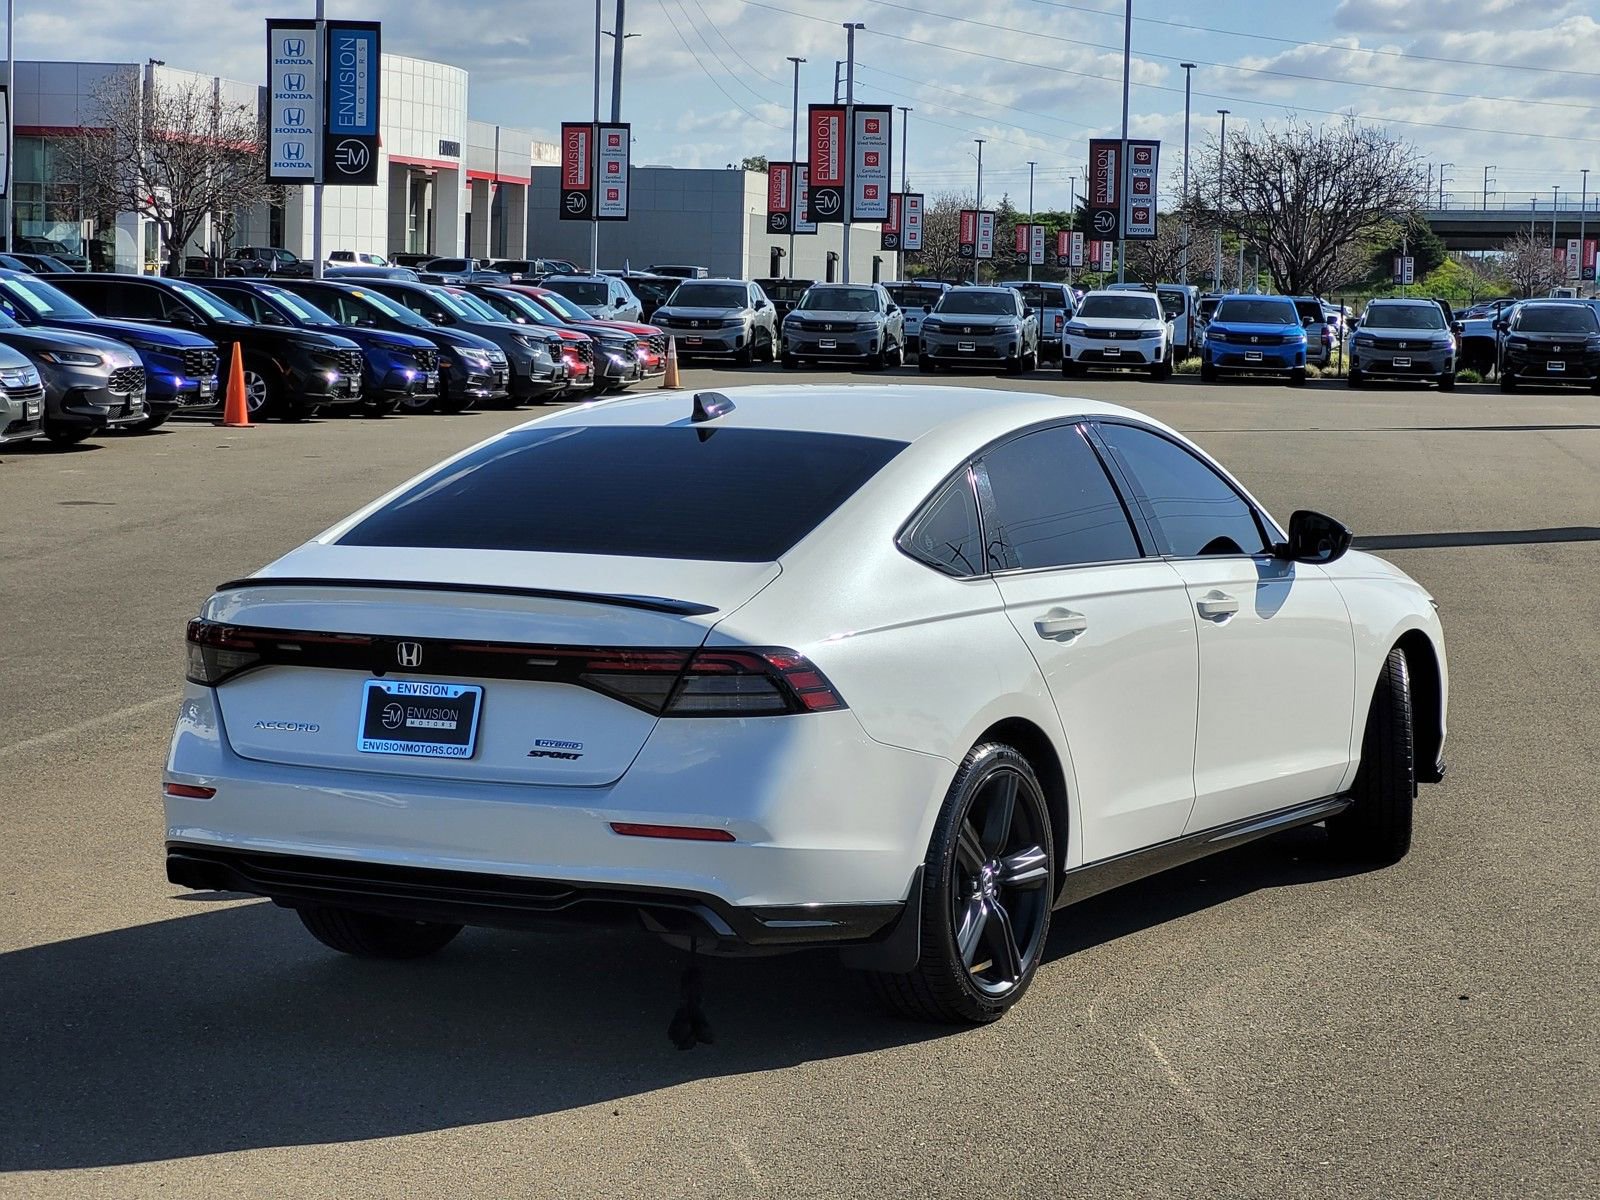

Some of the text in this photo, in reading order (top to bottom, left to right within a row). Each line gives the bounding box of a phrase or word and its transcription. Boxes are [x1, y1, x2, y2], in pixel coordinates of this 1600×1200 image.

[339, 37, 356, 126] ENVISION
[358, 46, 366, 119] MOTORS
[568, 131, 578, 185] ENVISION
[817, 116, 829, 180] ENVISION
[773, 168, 781, 208] ENVISION
[1096, 149, 1108, 203] ENVISION
[397, 683, 449, 696] ENVISION
[253, 720, 320, 733] ACCORD
[406, 706, 459, 721] ENVISION
[362, 740, 467, 756] ENVISIONMOTORS.COM
[527, 750, 584, 760] SPORT
[538, 739, 581, 750] HYBRID
